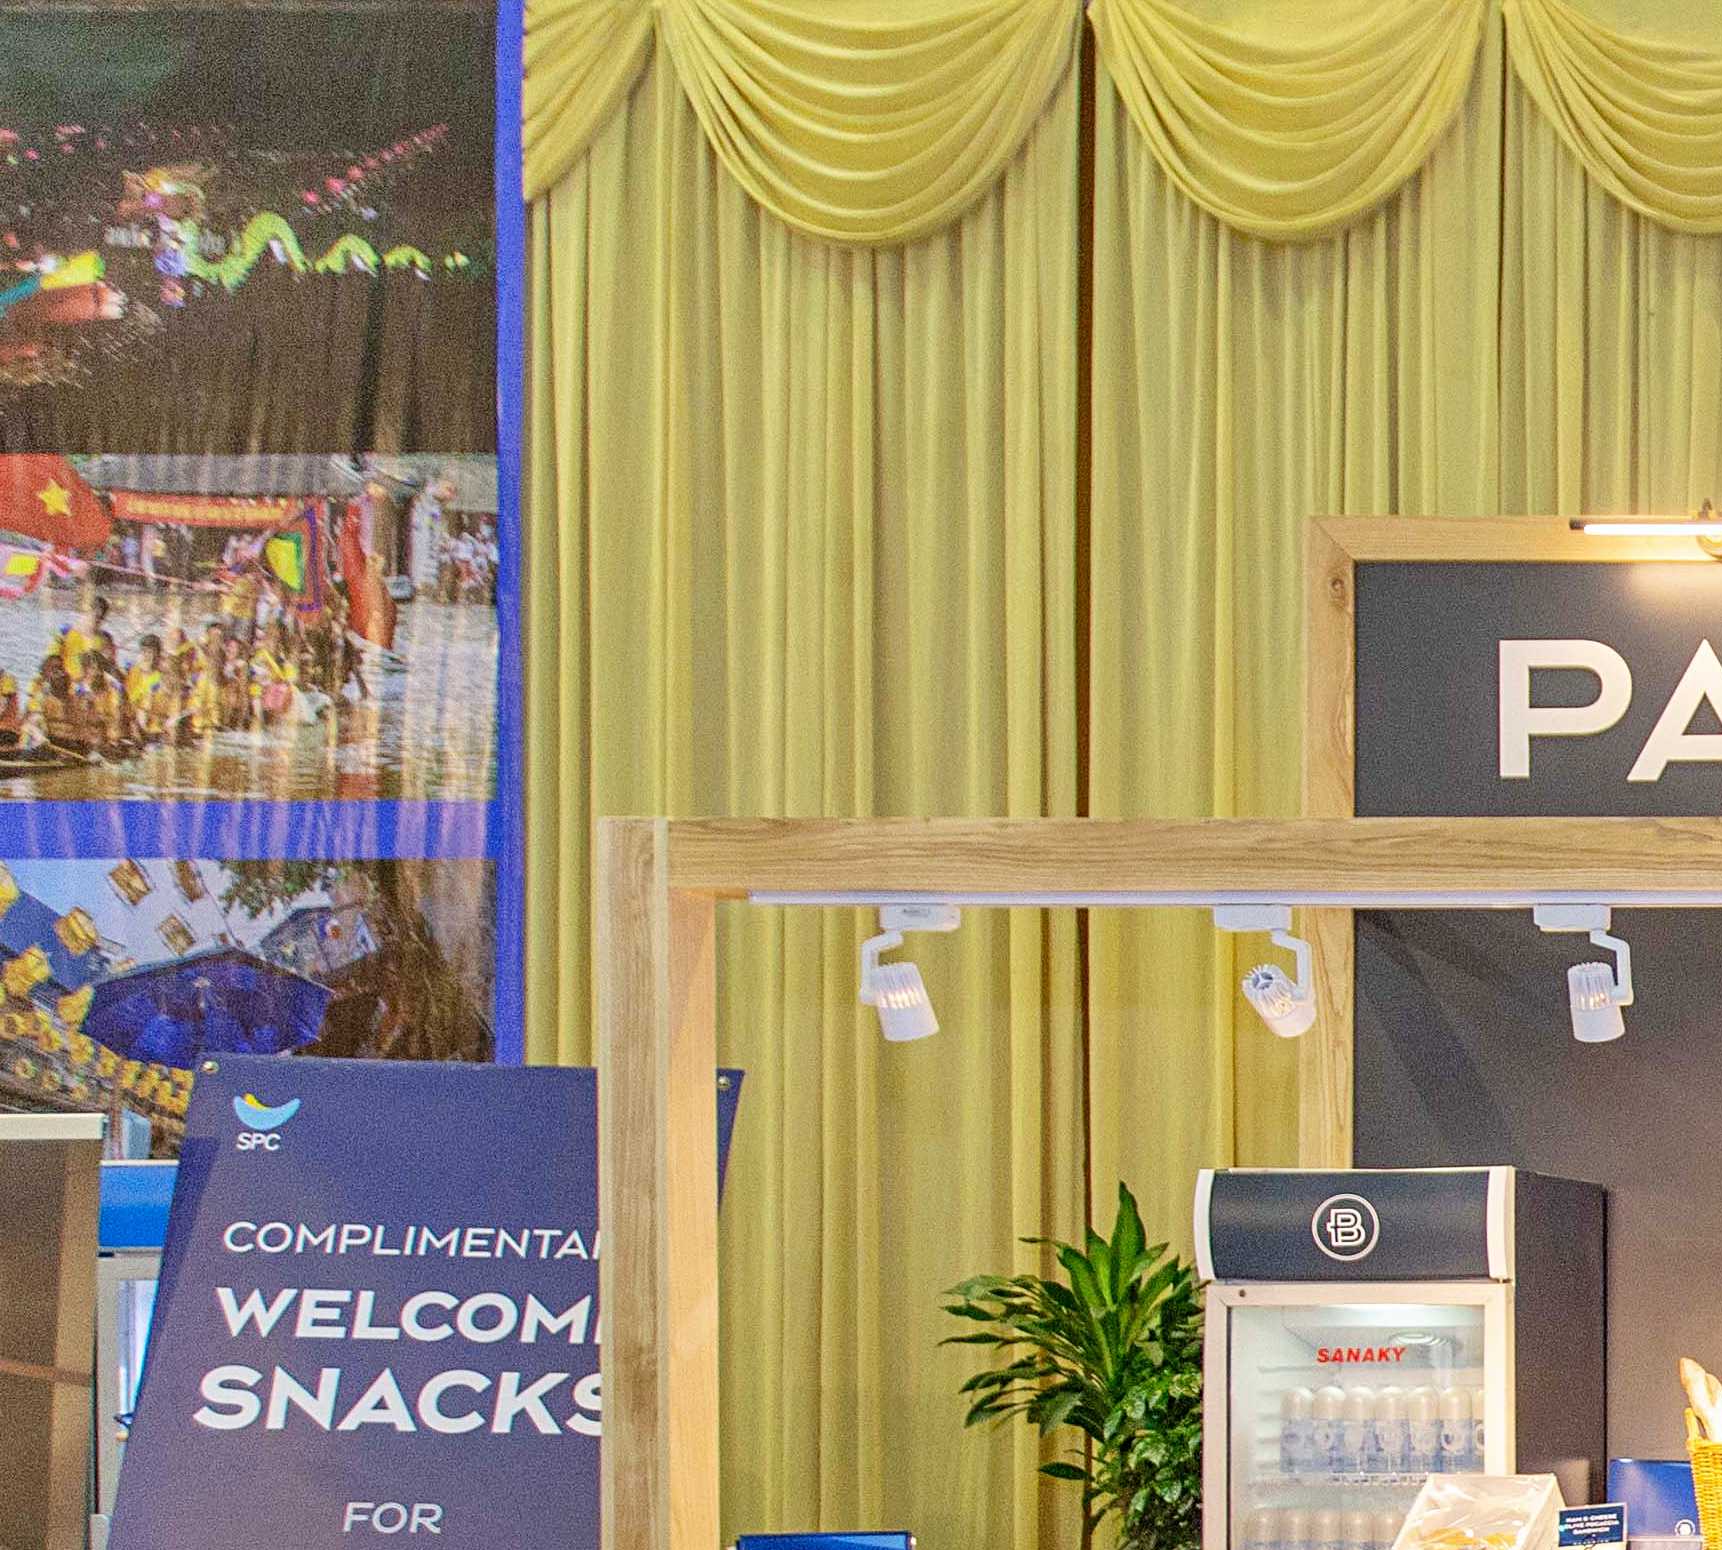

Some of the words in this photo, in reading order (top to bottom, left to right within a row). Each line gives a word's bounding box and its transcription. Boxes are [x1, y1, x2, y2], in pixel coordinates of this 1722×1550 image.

[236, 1133, 280, 1151] SPC
[224, 1222, 599, 1259] COMPLIMENTA
[217, 1287, 601, 1344] WELCOM
[1318, 1347, 1404, 1364] SANAKY
[343, 1502, 441, 1533] FOR
